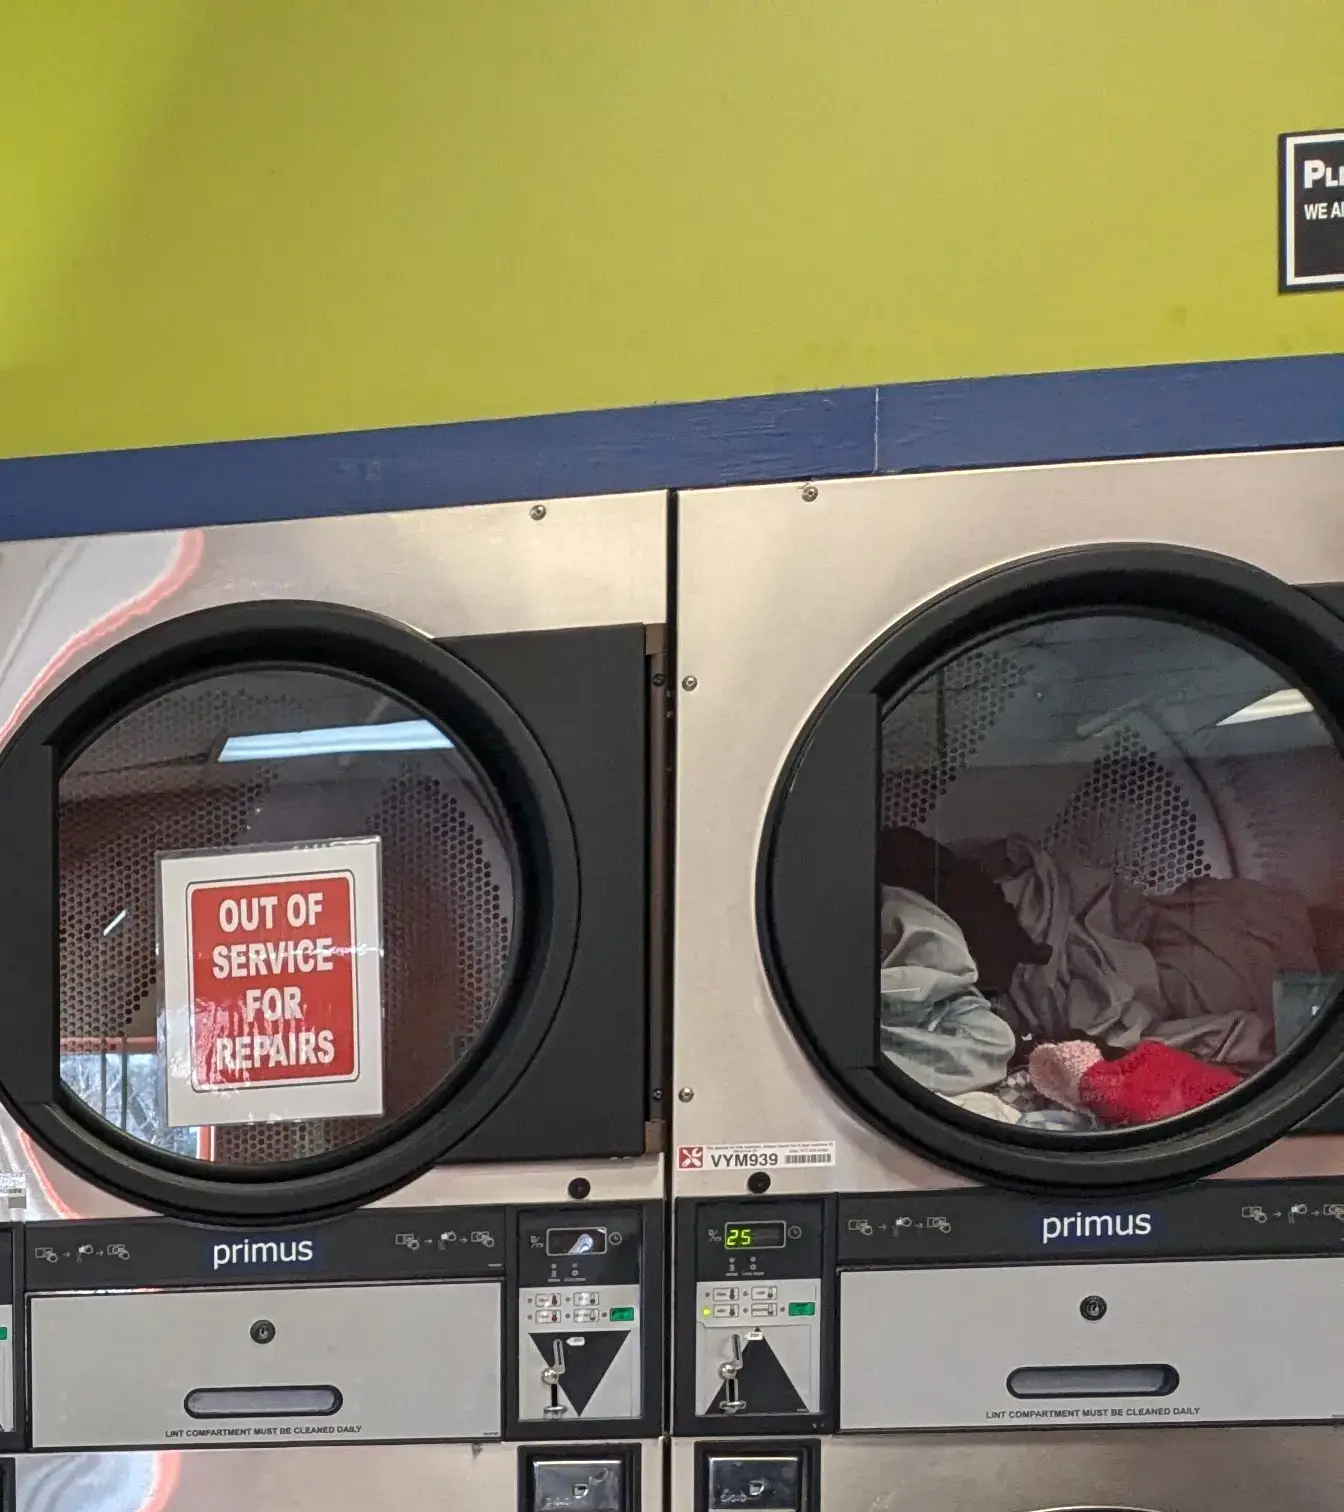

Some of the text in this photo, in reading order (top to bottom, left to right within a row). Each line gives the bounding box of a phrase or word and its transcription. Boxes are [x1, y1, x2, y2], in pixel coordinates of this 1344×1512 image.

[1304, 203, 1328, 220] WE
[219, 892, 323, 932] OUT OF
[213, 938, 333, 979] SERVICE
[246, 987, 302, 1022] FOR
[216, 1030, 334, 1070] REPAIRS
[710, 1153, 778, 1167] VYM939
[727, 1229, 752, 1246] 25
[1042, 1211, 1152, 1244] primus
[212, 1236, 314, 1270] primus
[986, 1411, 1006, 1419] LINT
[1008, 1410, 1080, 1418] COMPARTMENT
[186, 1429, 251, 1437] COMPARTMENT
